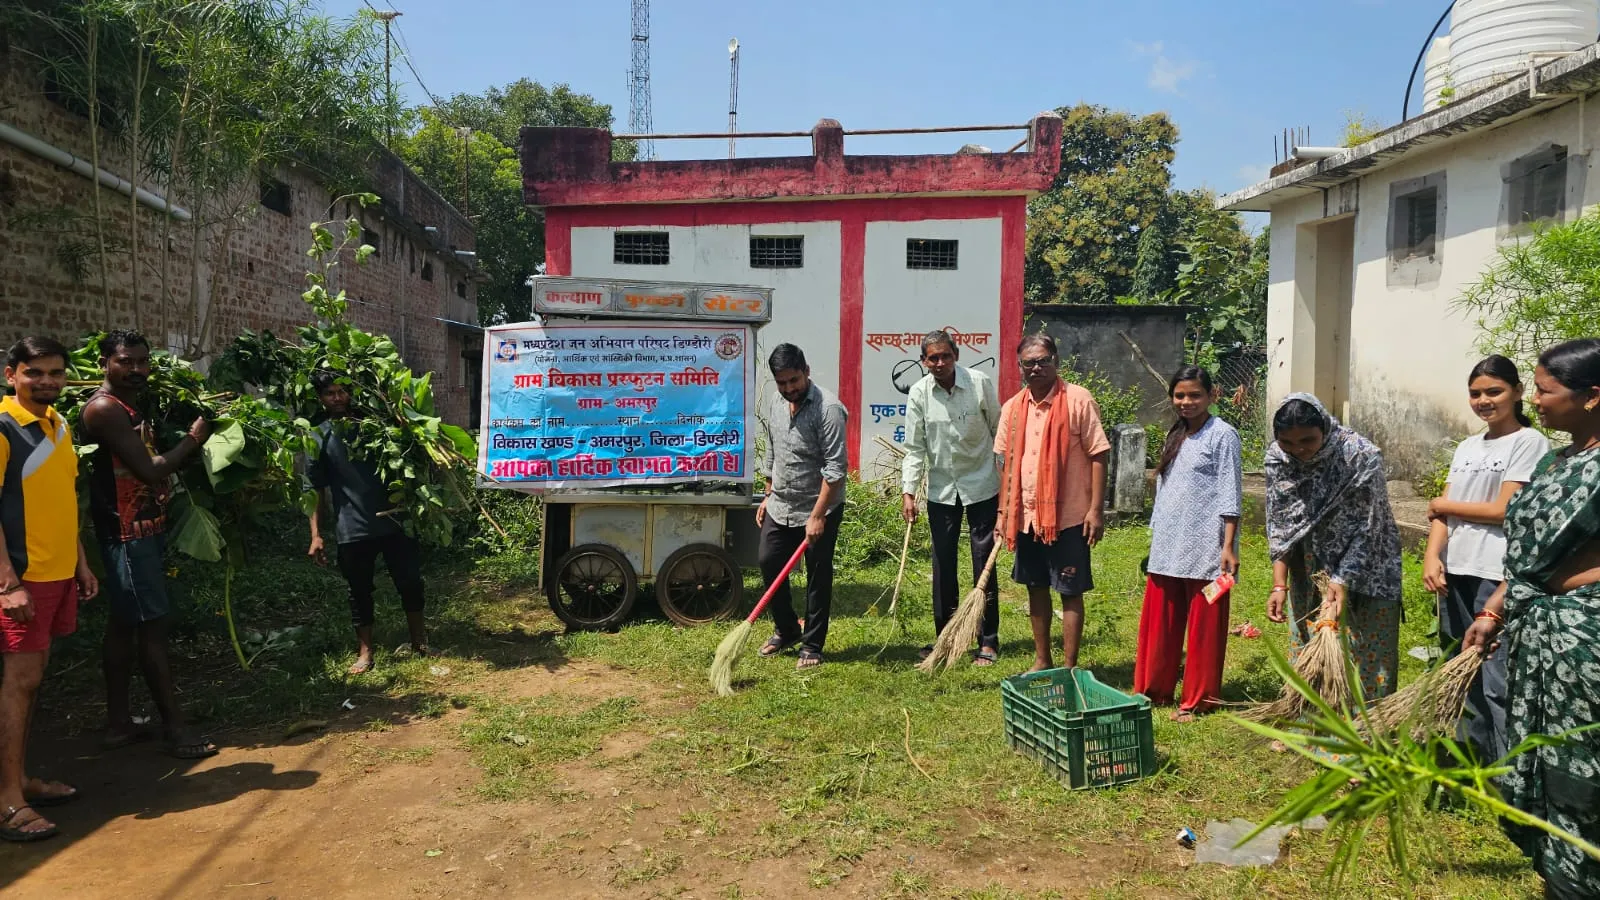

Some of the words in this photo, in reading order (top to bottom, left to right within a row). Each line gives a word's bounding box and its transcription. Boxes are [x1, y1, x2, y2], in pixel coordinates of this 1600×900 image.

[523, 336, 565, 349] मध्यप्रदेश
[568, 339, 585, 349] जन
[590, 335, 634, 349] अभियान
[514, 373, 543, 388] ग्राम
[547, 367, 602, 388] विकास
[670, 366, 719, 386] समिति
[615, 397, 657, 413] अमरपुर
[870, 404, 896, 423] एक
[493, 433, 537, 449] विकास
[540, 436, 575, 449] खण्ड
[491, 459, 553, 477] आपका
[557, 454, 613, 476] हार्दिक
[616, 456, 672, 474] स्वागत
[676, 450, 718, 472] करती
